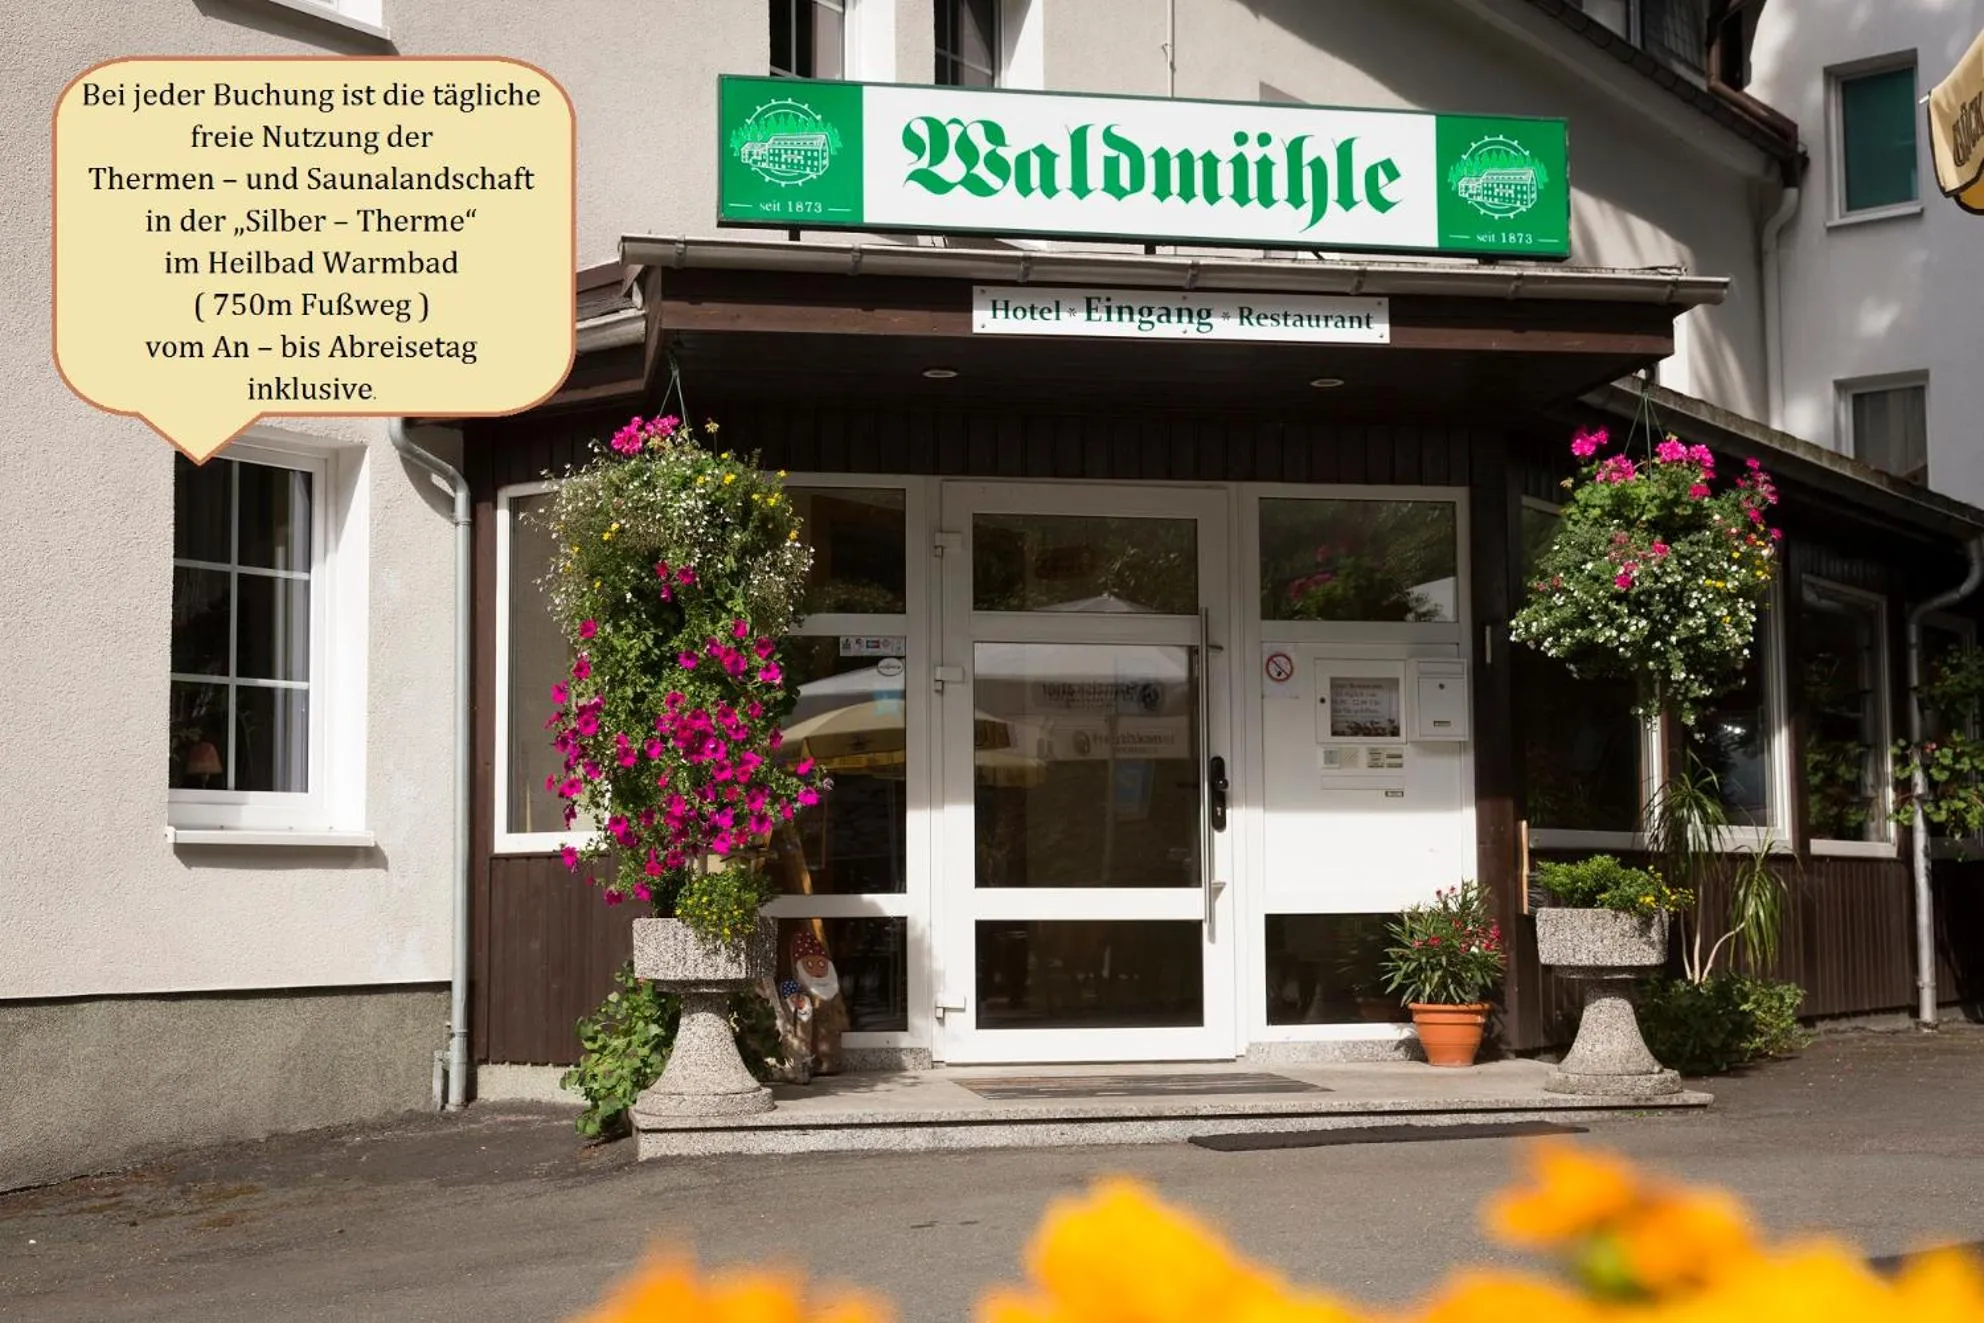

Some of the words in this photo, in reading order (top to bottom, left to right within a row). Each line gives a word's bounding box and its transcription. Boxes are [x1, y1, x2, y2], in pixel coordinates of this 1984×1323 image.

[901, 115, 1403, 233] Waldmühle
[759, 200, 781, 213] seit
[787, 200, 823, 214] 1873
[1476, 232, 1496, 243] seit
[1501, 232, 1534, 245] 1873
[990, 298, 1062, 322] Hotel
[1085, 296, 1214, 333] Eingang
[1238, 305, 1374, 330] Restaurant
